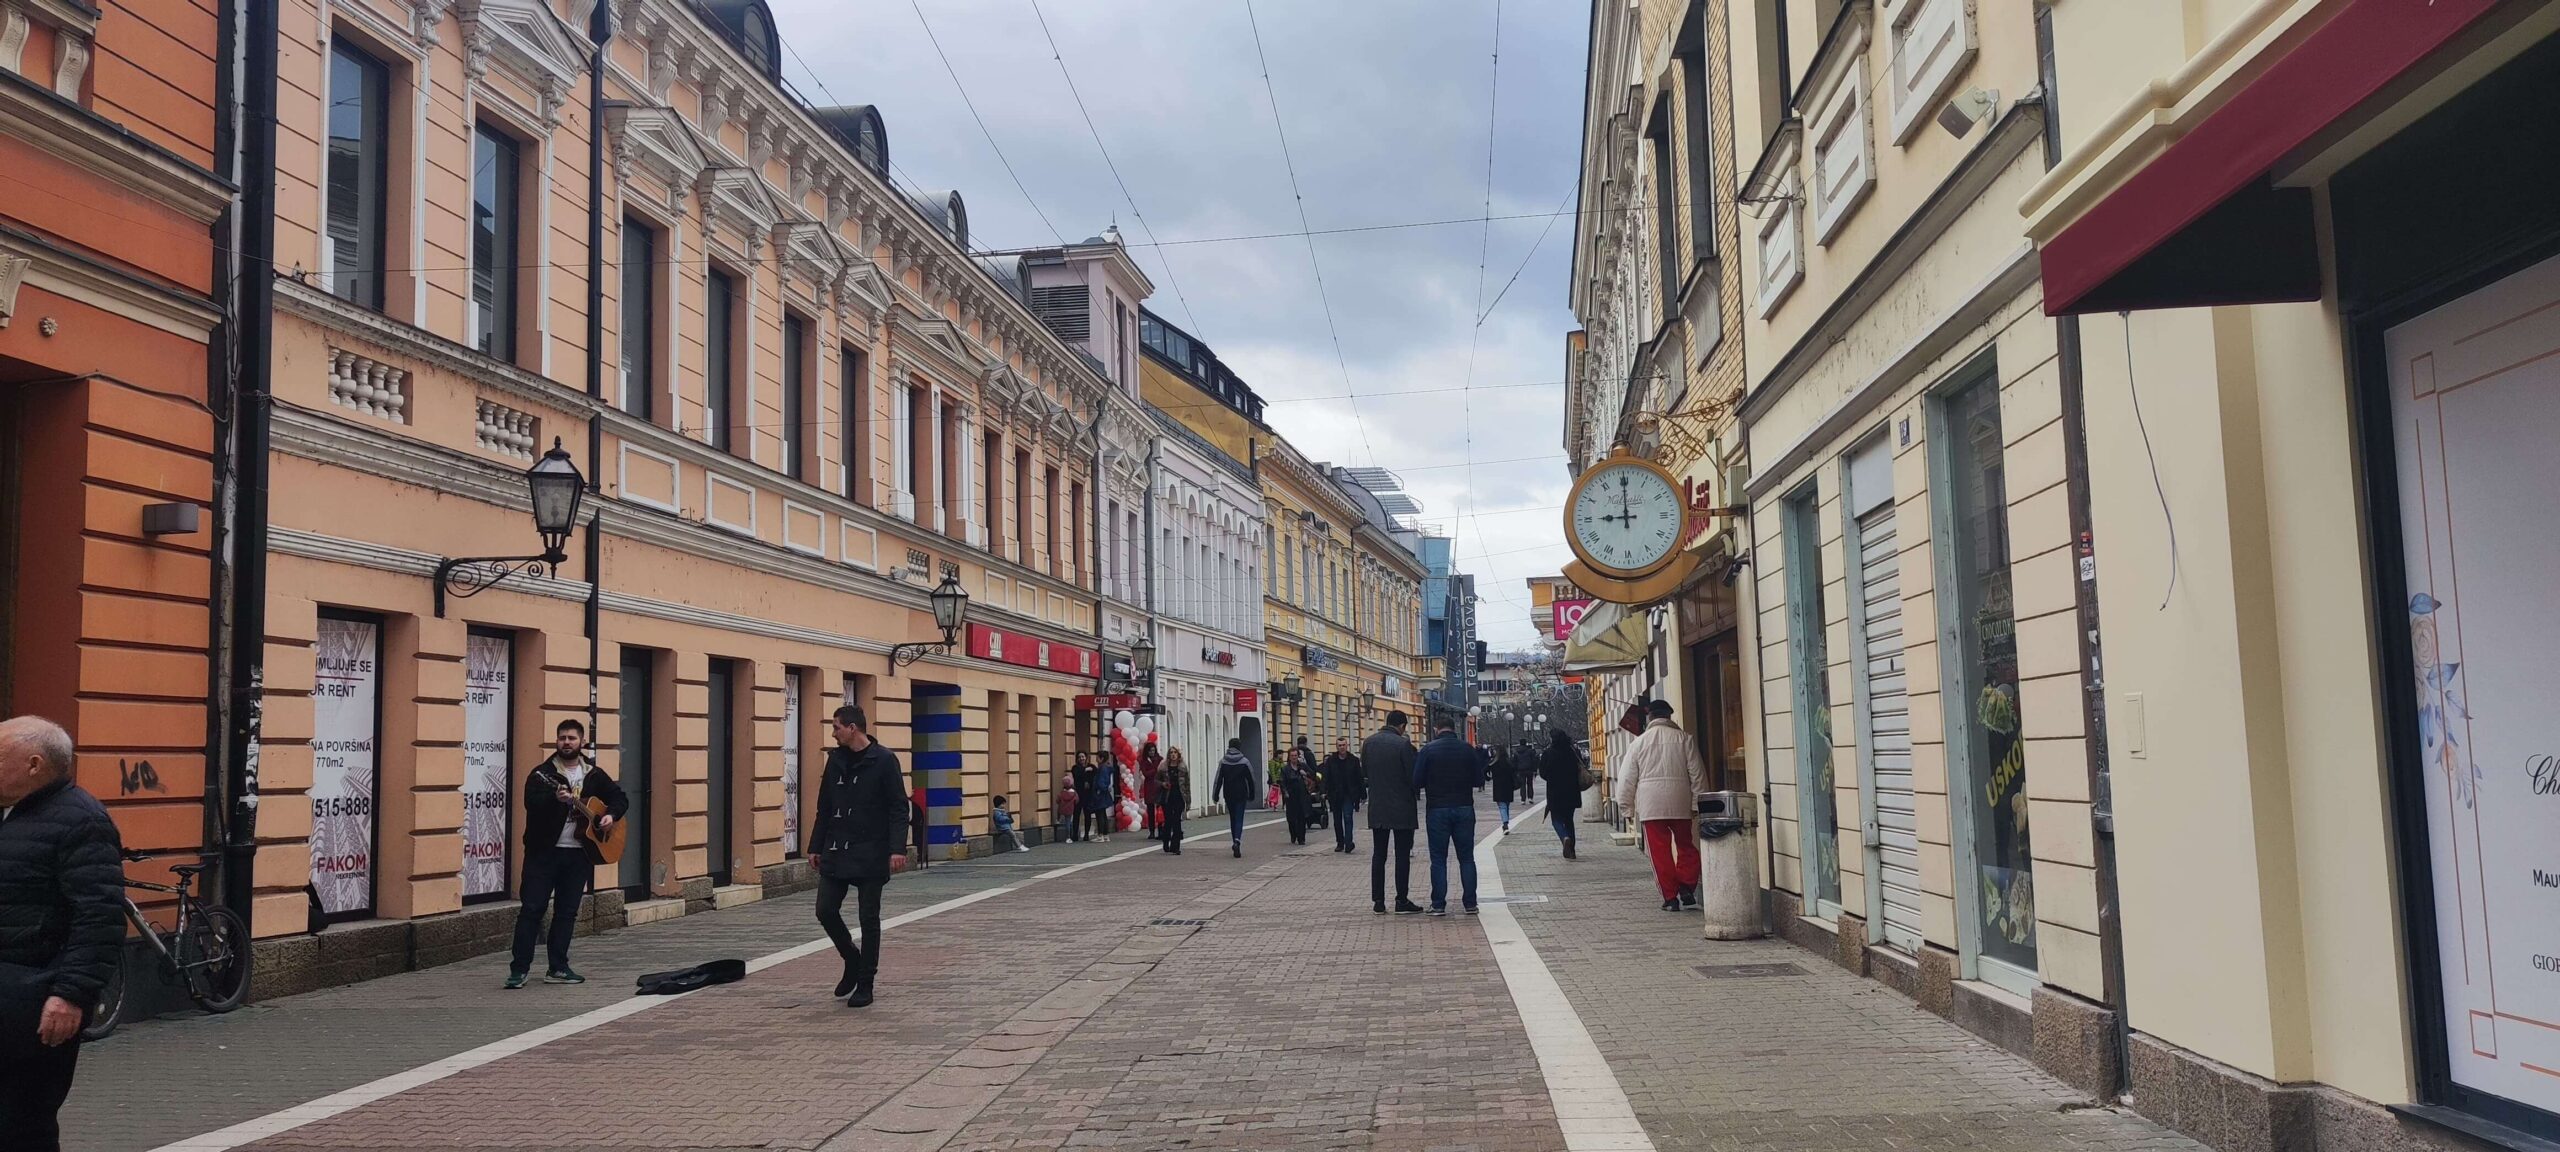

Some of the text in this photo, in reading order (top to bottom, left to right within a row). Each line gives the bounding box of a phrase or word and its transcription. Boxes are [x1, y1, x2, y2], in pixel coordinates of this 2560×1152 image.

[1464, 595, 1477, 688] Terranova
[315, 657, 372, 673] MLJUJE SE
[496, 672, 506, 682] SE
[328, 684, 356, 698] RENT
[471, 692, 494, 704] RENT
[326, 738, 372, 753] POVRŠINA
[471, 740, 506, 753] POVRŠINA
[316, 756, 344, 768] 770m2
[2525, 753, 2560, 795] Ch
[463, 841, 502, 859] FAKOM
[316, 853, 367, 874] FAKOM
[2532, 868, 2560, 889] MAU
